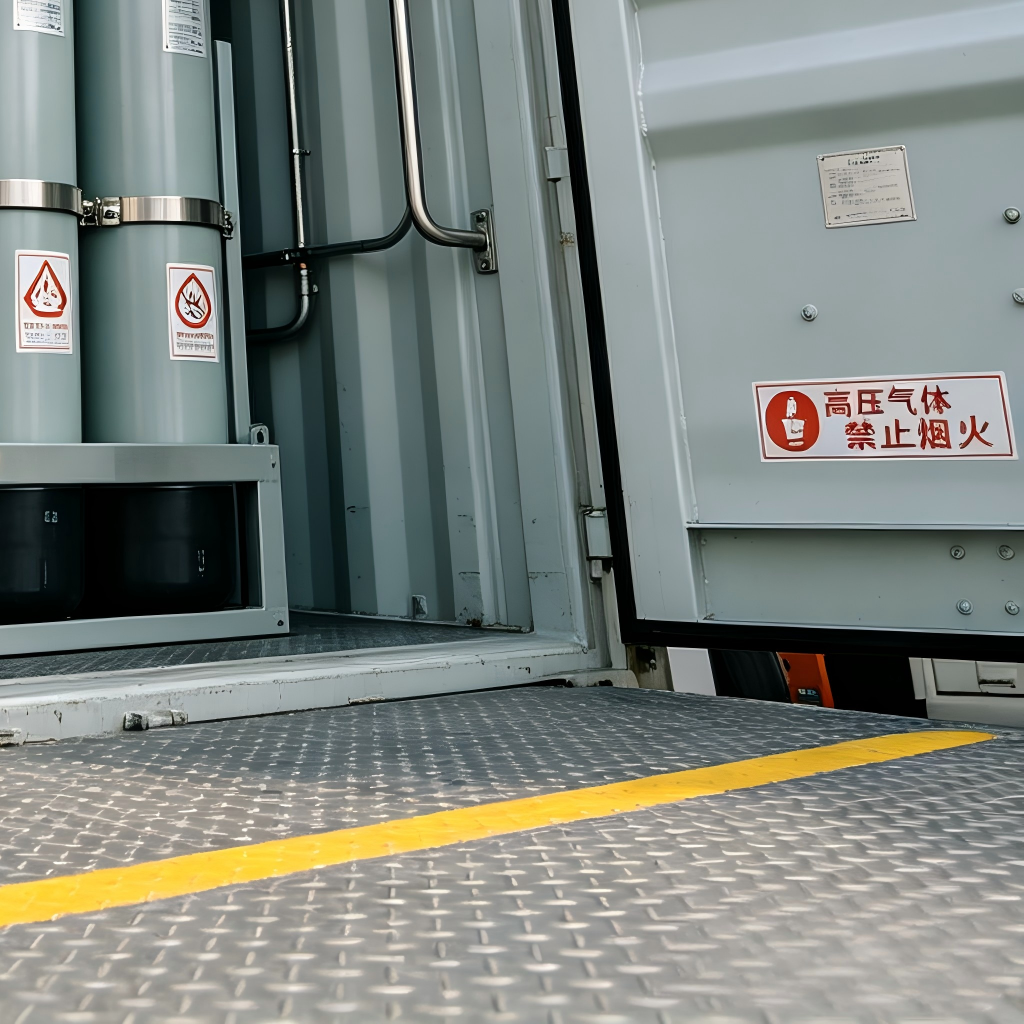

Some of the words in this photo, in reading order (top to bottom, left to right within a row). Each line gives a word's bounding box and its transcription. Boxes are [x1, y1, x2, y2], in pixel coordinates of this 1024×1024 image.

[823, 384, 951, 417] 高压气体
[844, 414, 994, 451] 禁止烟火
